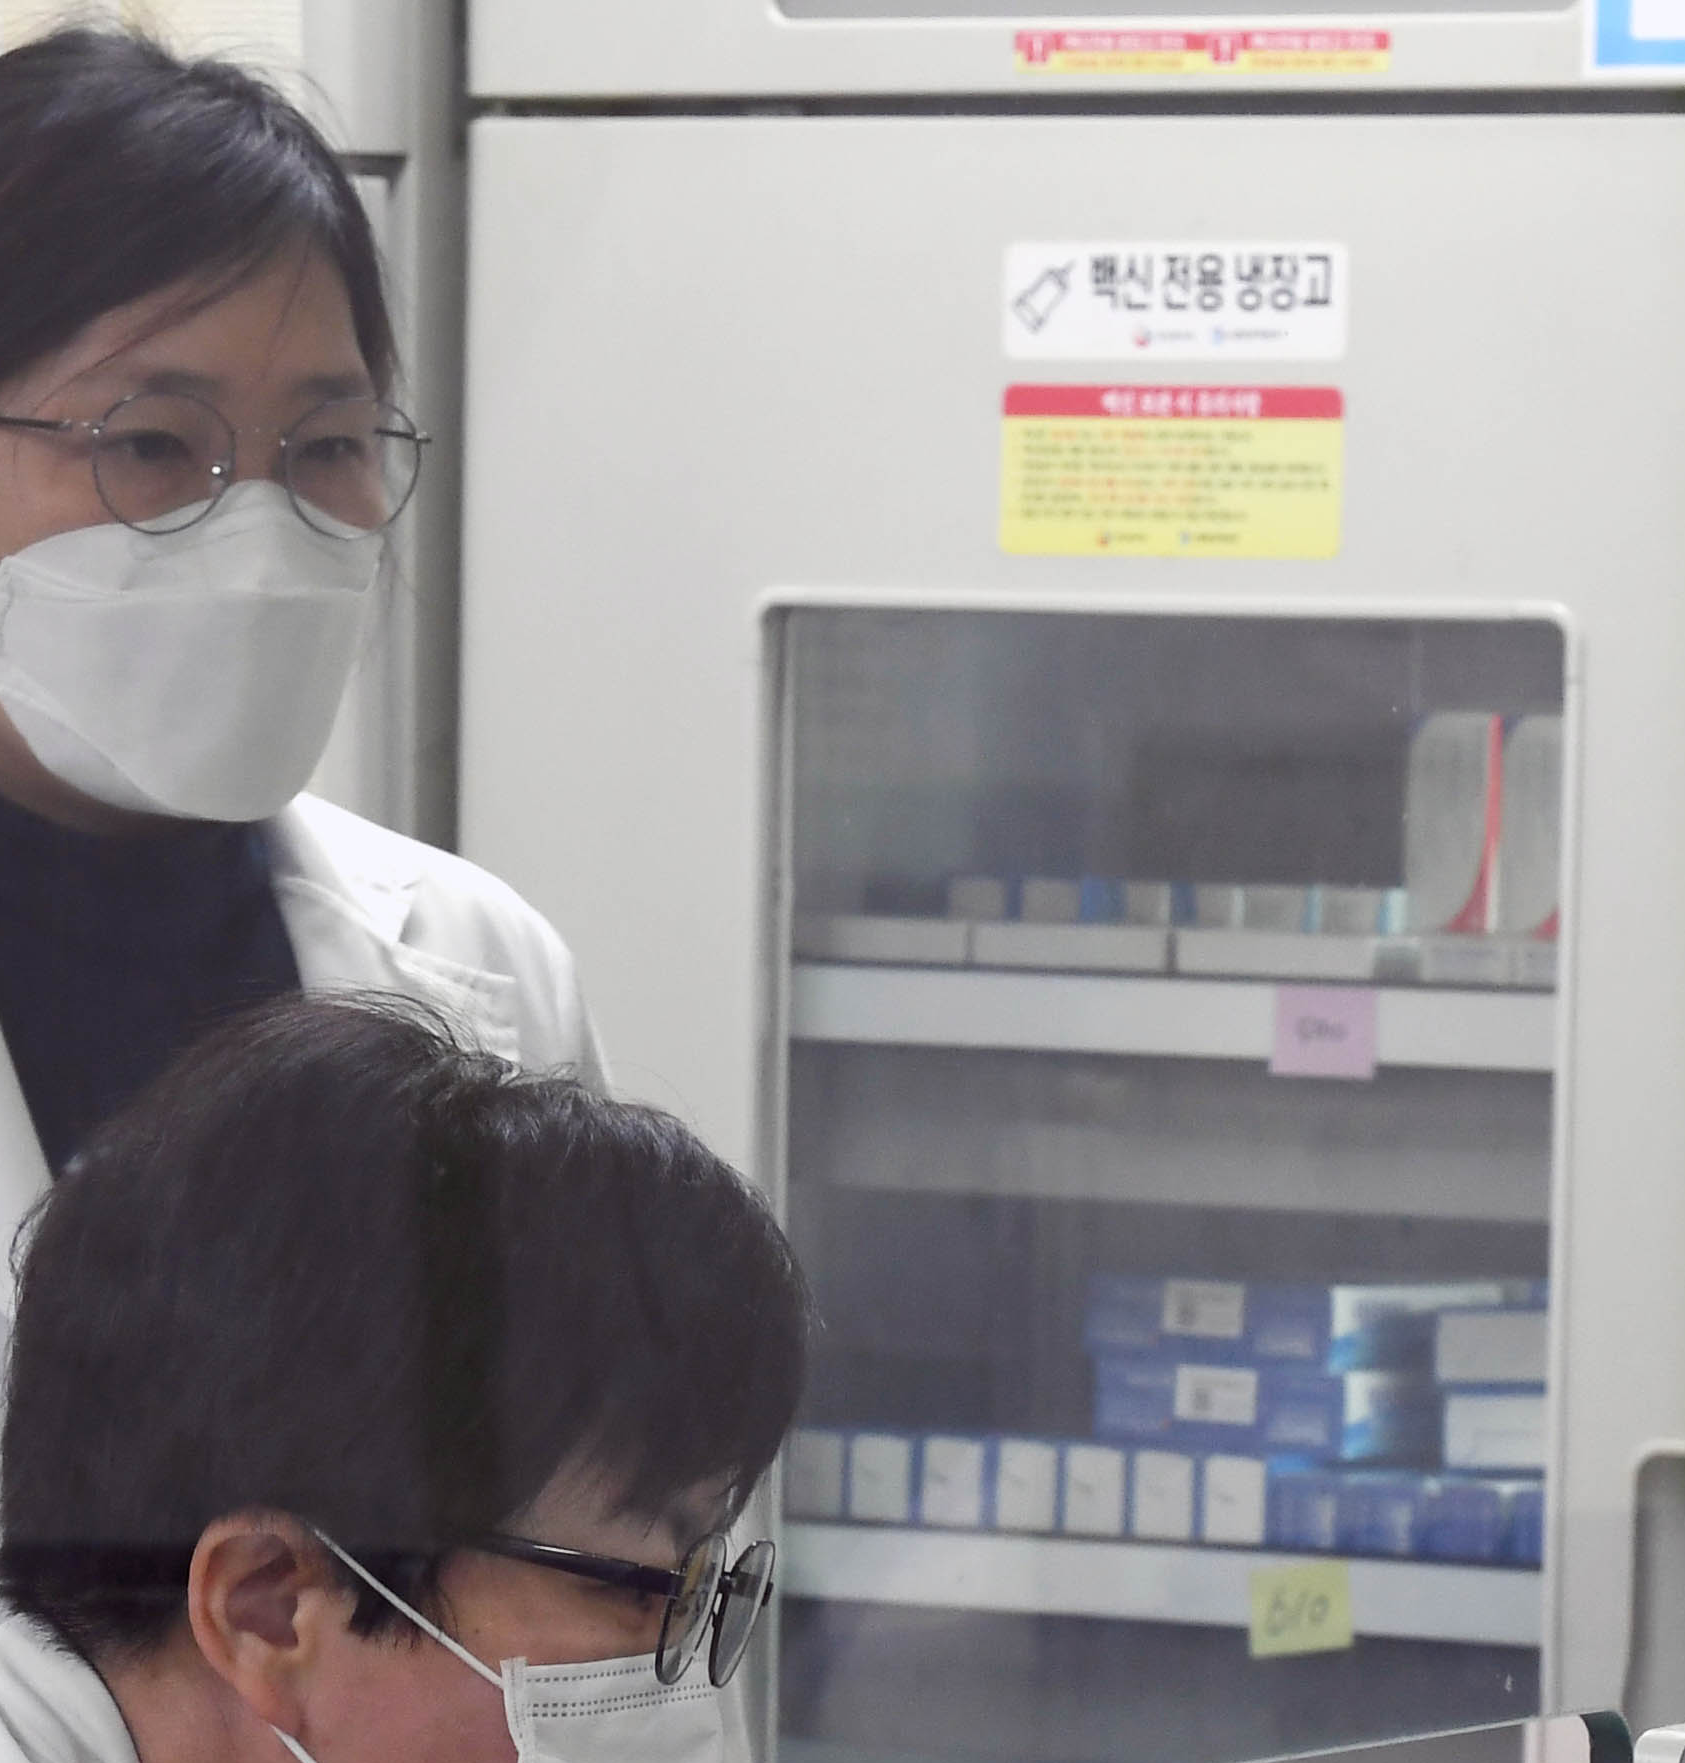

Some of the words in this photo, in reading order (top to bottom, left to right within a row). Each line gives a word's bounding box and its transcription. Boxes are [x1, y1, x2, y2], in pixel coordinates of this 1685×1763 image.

[1089, 254, 1154, 311] 백신
[1163, 254, 1224, 312] 전용
[1234, 254, 1332, 312] 냉장고
